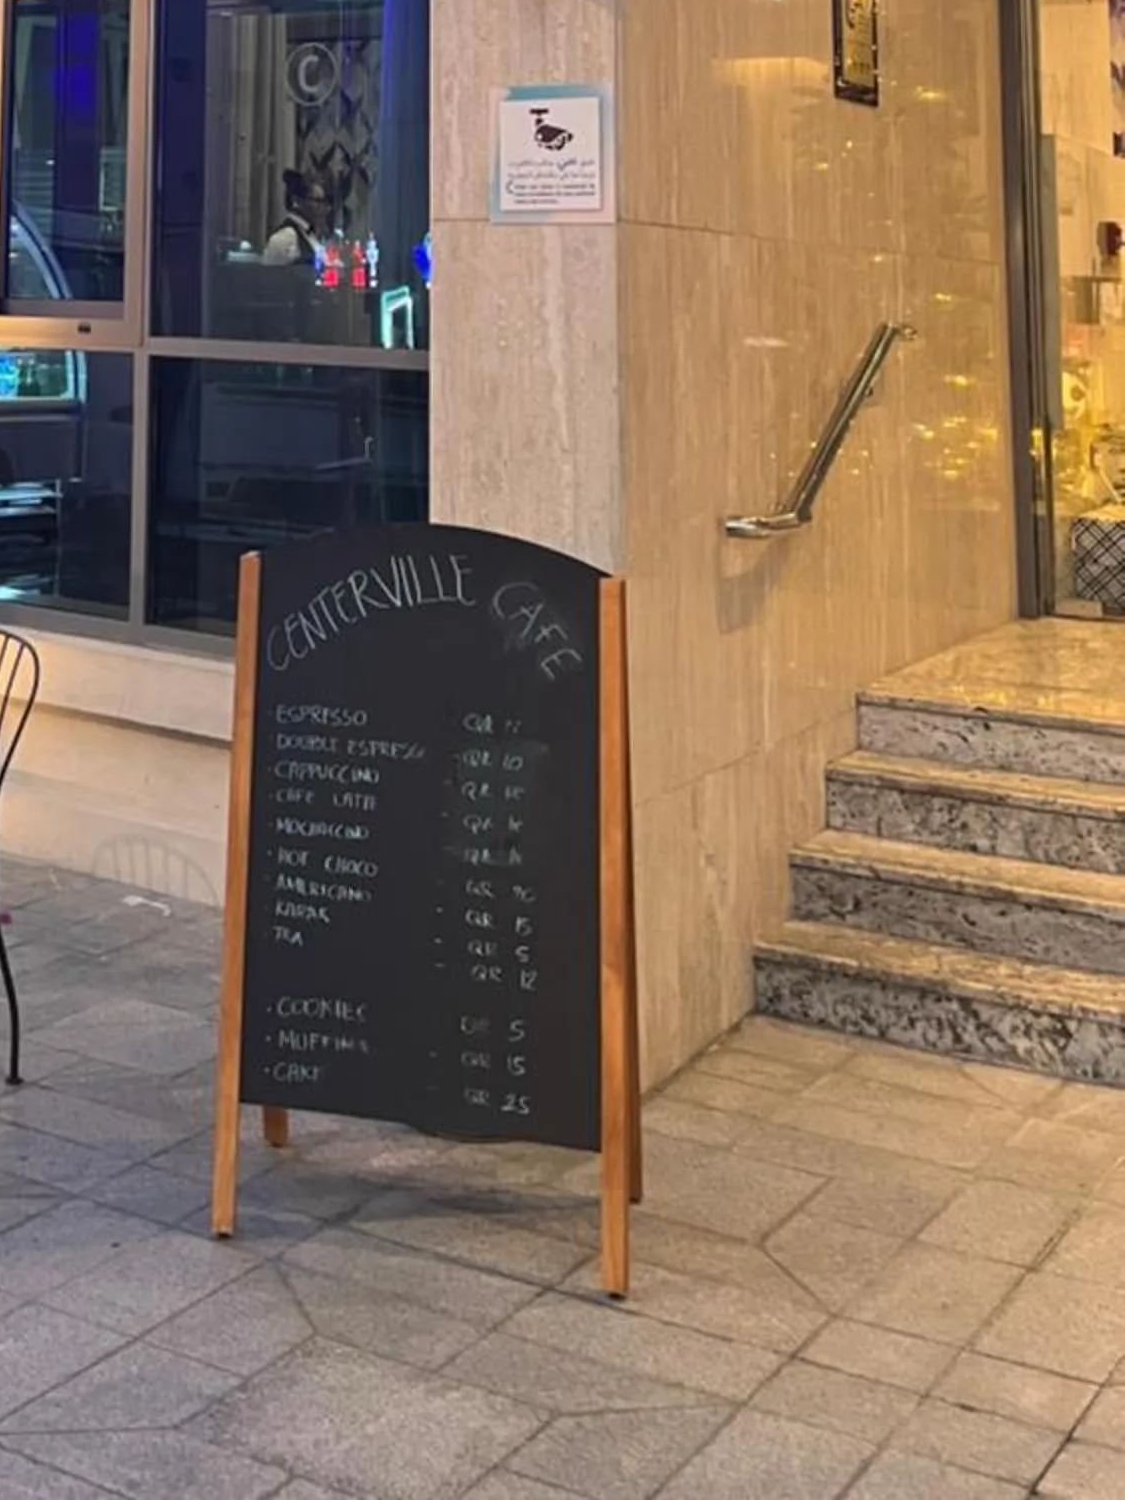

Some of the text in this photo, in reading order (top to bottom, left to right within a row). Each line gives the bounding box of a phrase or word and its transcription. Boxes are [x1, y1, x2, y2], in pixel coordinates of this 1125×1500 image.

[267, 554, 583, 680] CENTERVILLE CAFE
[276, 704, 368, 727] ESPRESSO
